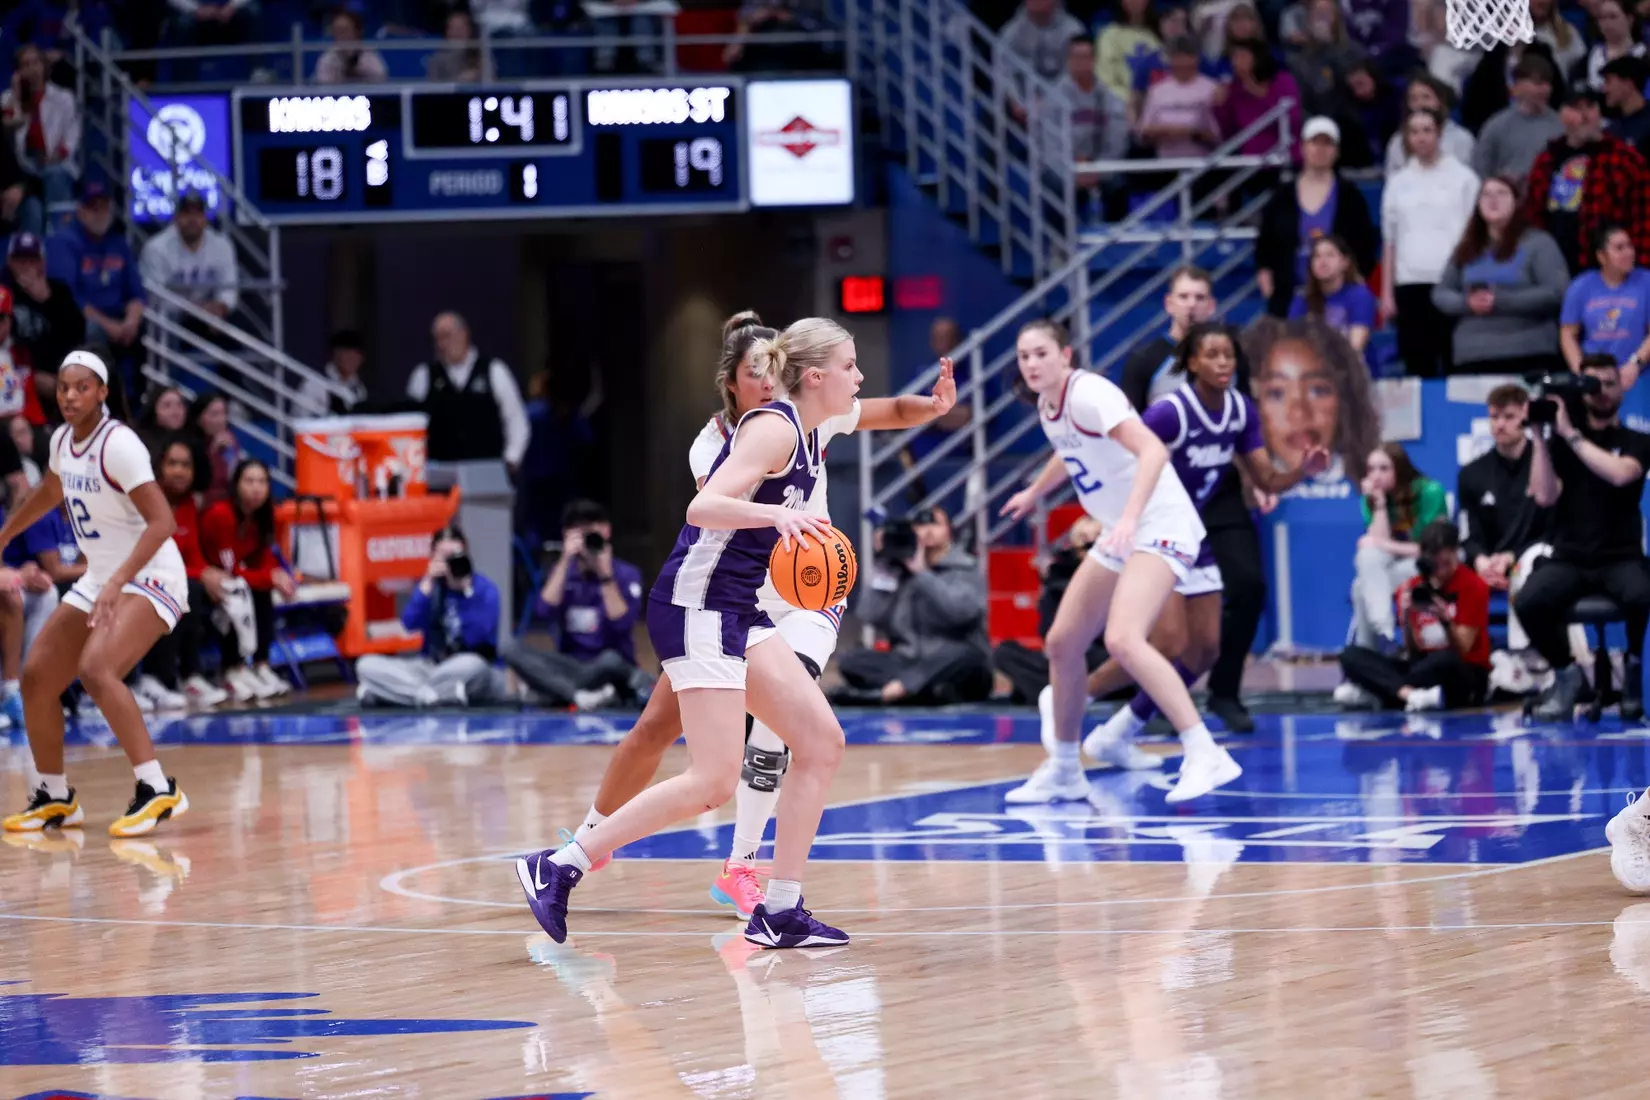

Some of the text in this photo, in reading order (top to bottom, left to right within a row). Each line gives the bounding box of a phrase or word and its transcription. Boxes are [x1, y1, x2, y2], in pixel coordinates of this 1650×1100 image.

[468, 95, 568, 143] 1:41
[296, 146, 343, 200] 18
[523, 163, 538, 199] 1
[674, 137, 723, 187] 19
[65, 496, 101, 539] 12
[831, 543, 849, 602] Wilson
